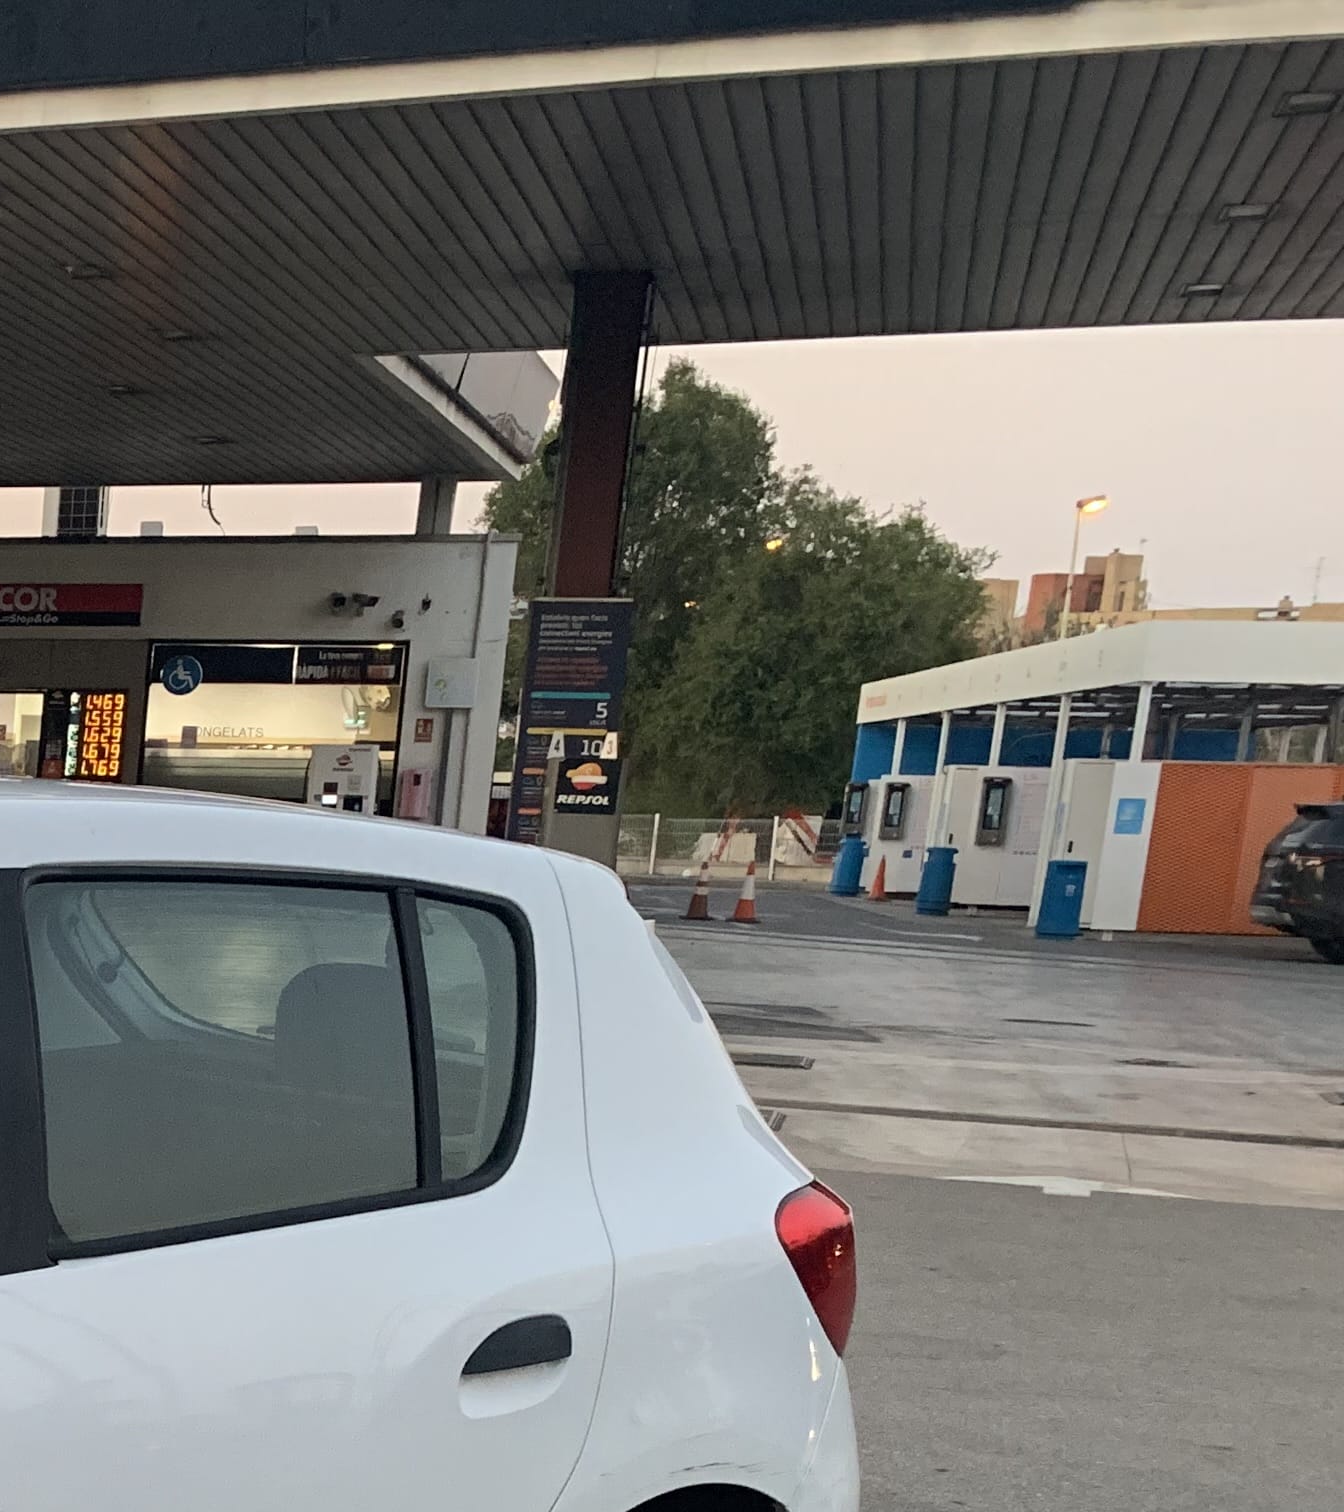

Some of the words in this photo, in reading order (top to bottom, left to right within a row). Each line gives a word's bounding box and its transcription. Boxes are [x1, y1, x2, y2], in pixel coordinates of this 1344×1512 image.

[86, 694, 125, 710] 1.469
[84, 710, 124, 726] 1.559
[595, 702, 608, 719] 5
[83, 727, 123, 743] 1.629
[82, 743, 121, 759] 1.679
[80, 759, 120, 777] 1.769
[556, 794, 610, 806] REPSOL
